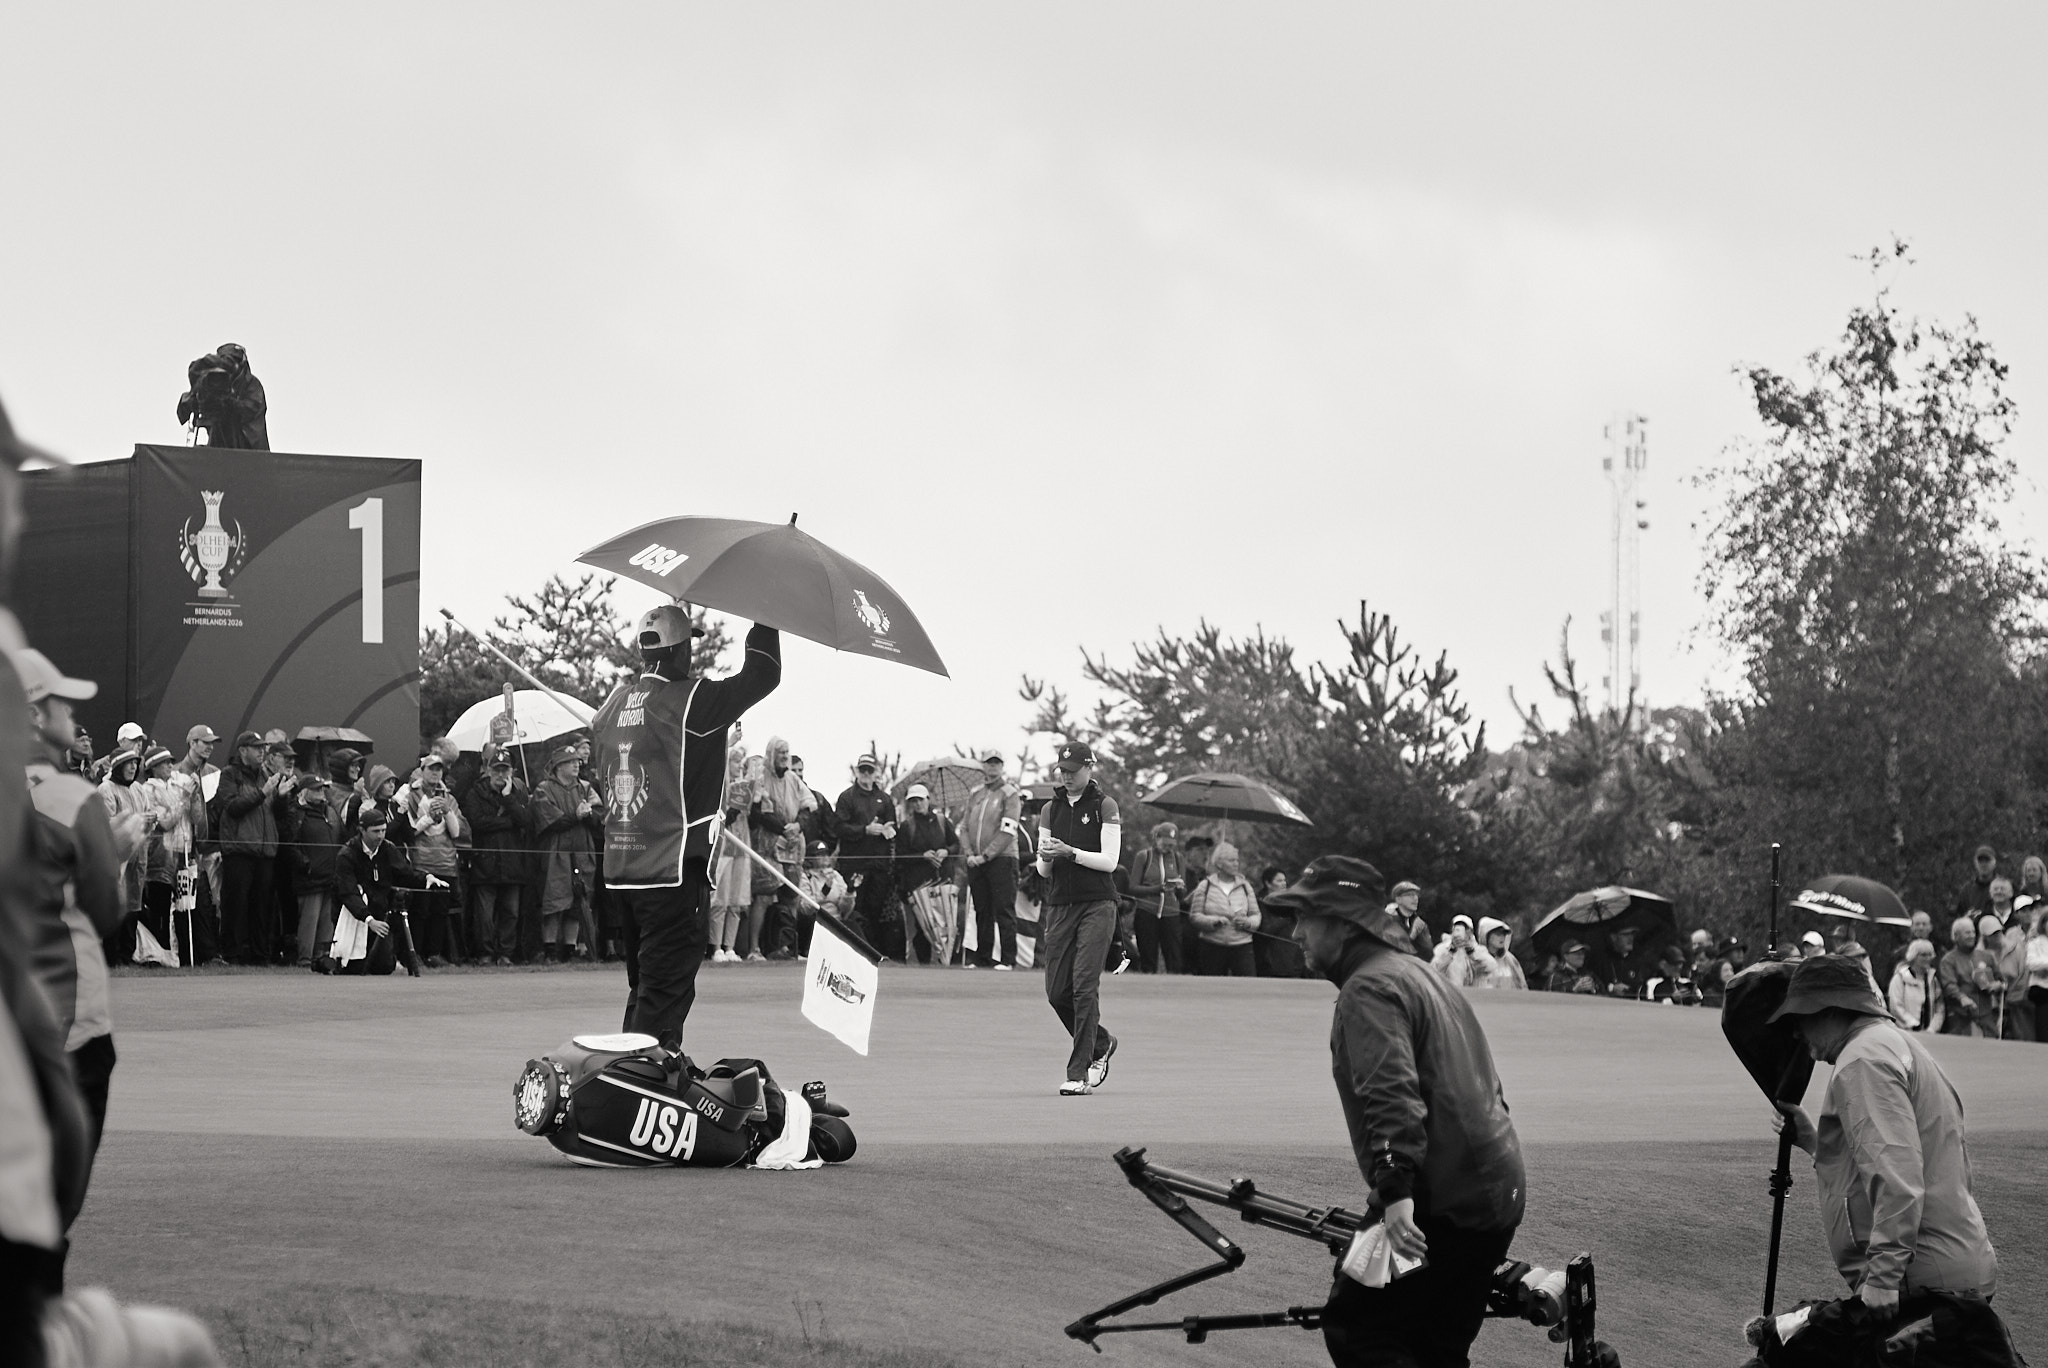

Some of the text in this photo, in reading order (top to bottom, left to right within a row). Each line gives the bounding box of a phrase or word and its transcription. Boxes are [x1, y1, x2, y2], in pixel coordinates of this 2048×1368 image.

[189, 533, 237, 548] SOLHEIM
[202, 546, 223, 557] CUP
[629, 543, 689, 577] USA
[349, 497, 383, 644] 1
[183, 617, 243, 627] NETHERLANDS 2026
[194, 608, 232, 617] BERNARDUS
[617, 708, 644, 727] KORDA
[696, 1096, 724, 1122] USA
[629, 1098, 698, 1161] USA
